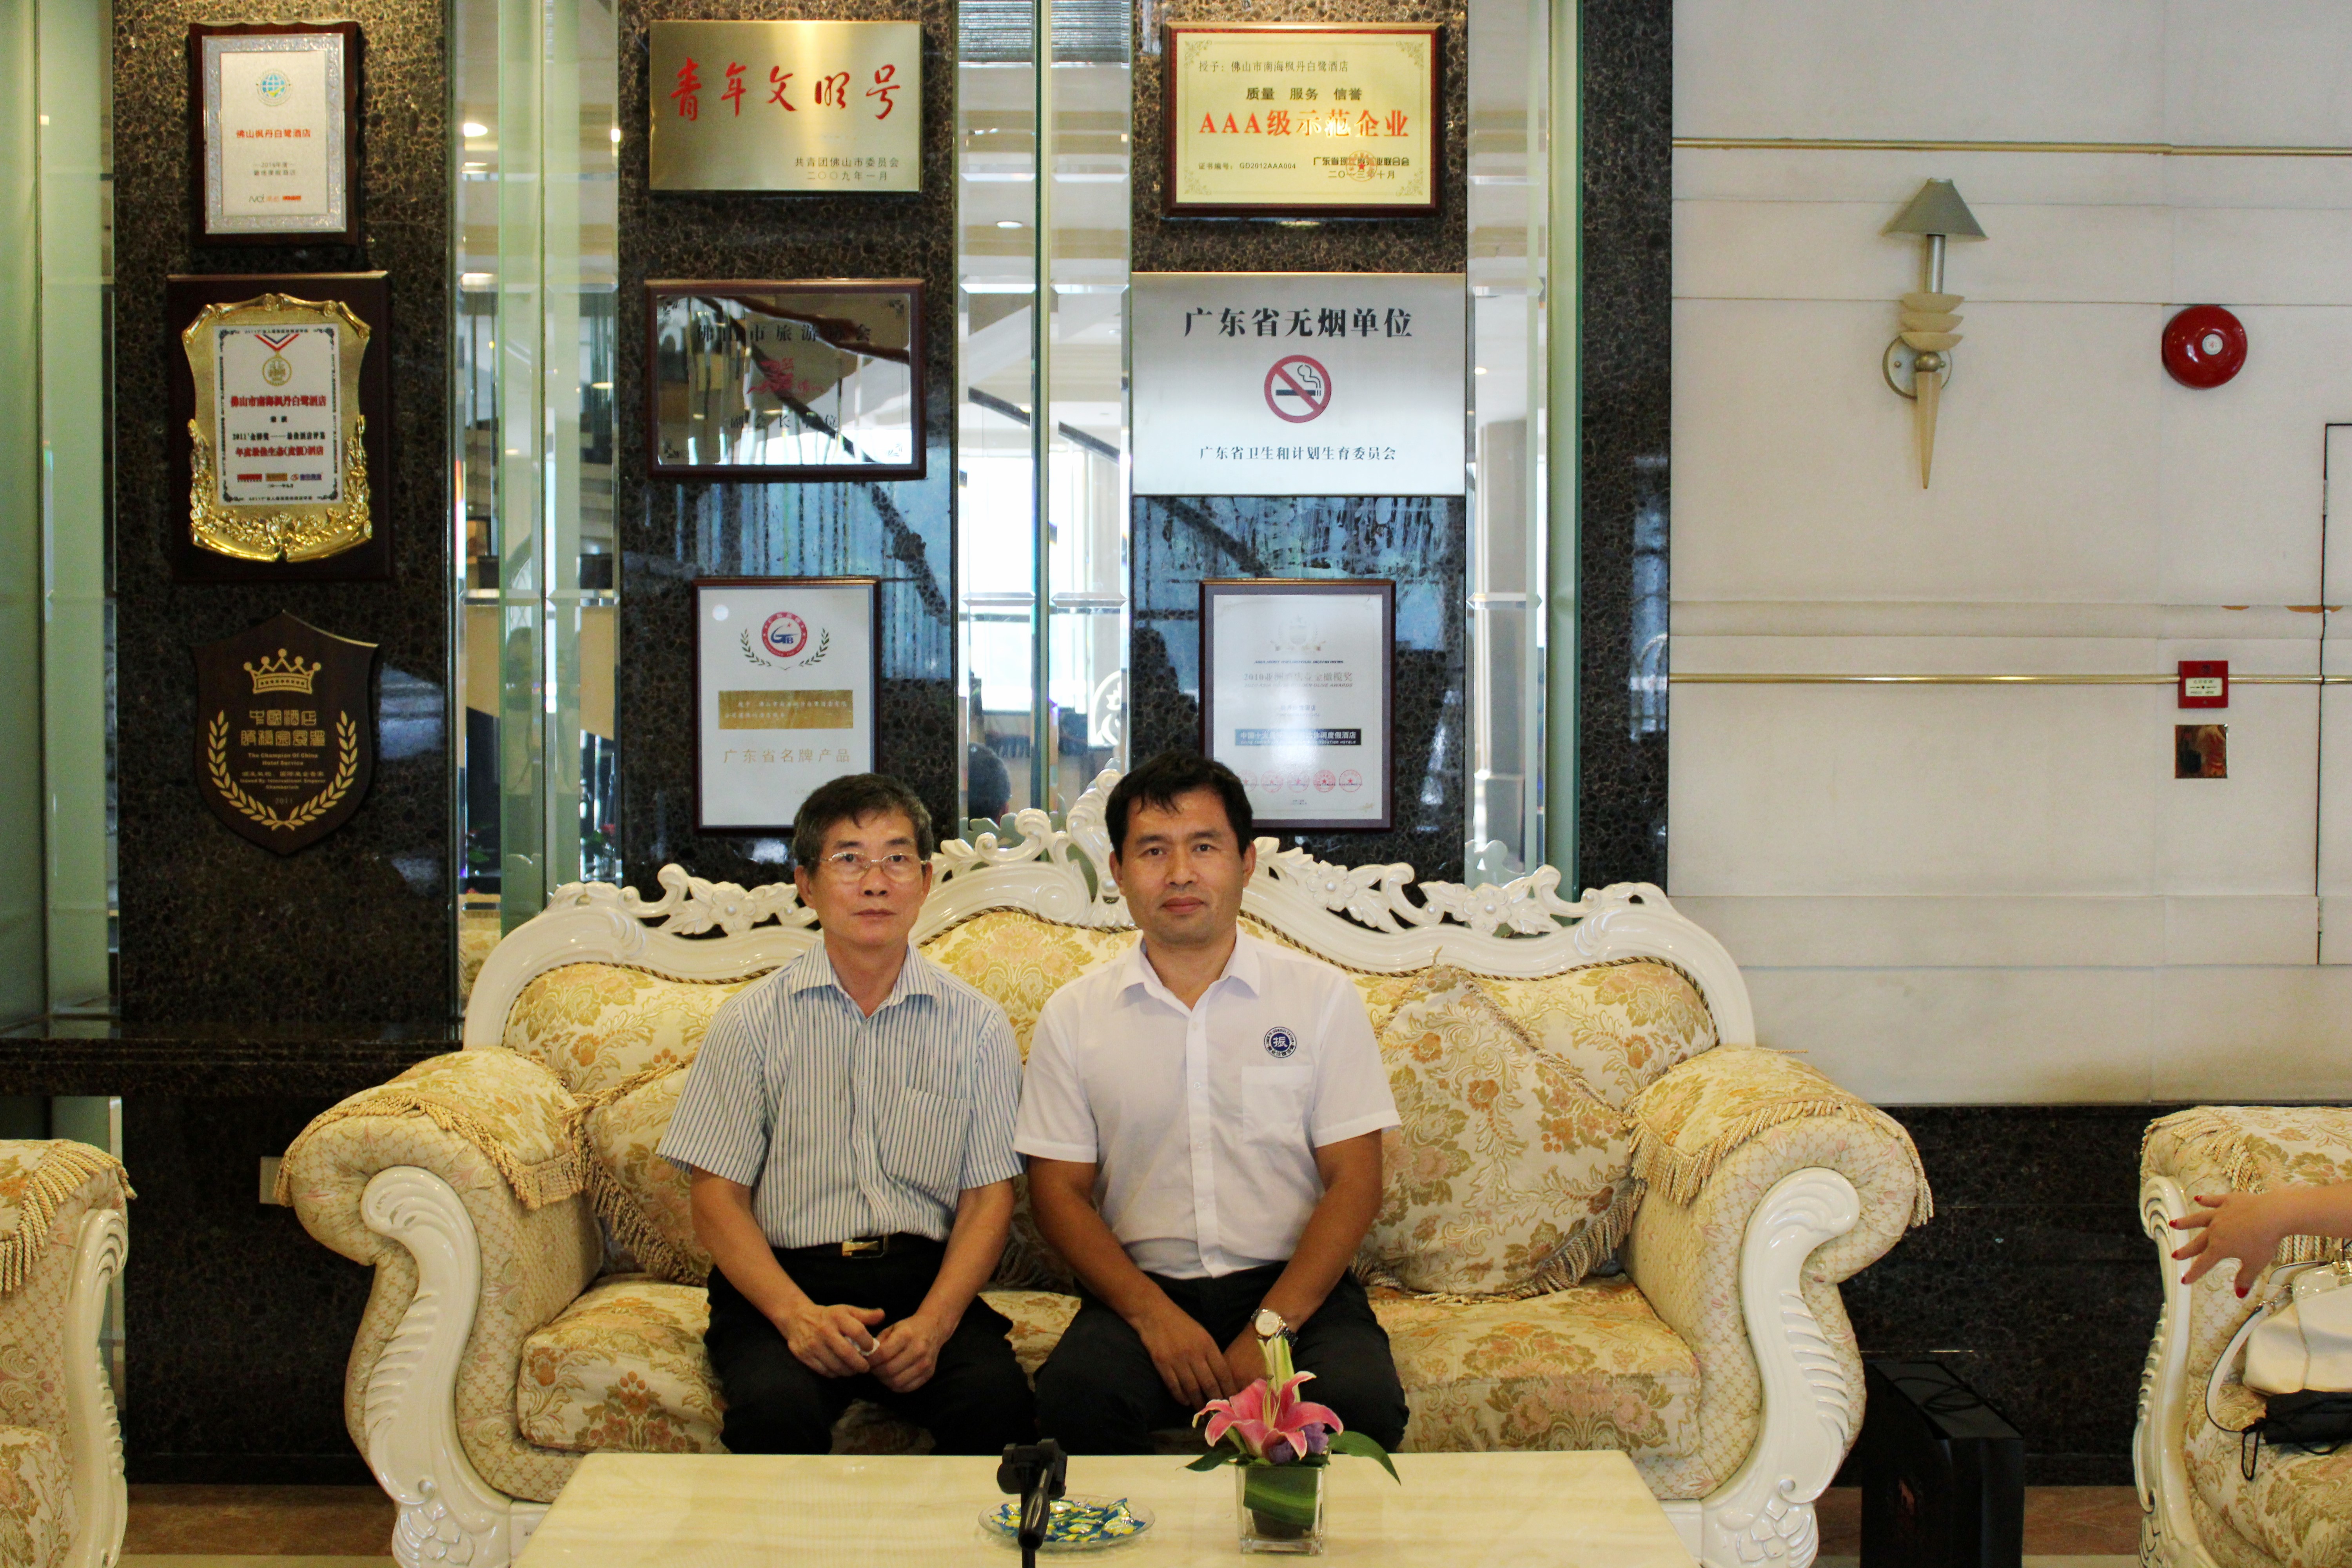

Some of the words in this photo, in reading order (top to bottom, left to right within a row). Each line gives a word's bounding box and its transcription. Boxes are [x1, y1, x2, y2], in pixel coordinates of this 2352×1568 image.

[671, 57, 900, 121] 青年文明号
[1247, 87, 1274, 100] 质量
[1290, 87, 1318, 100] 服务
[1334, 87, 1362, 100] 信誉
[795, 157, 898, 167] 共青团佛山市委员会
[1184, 307, 1412, 338] 广东省无烟单位
[1200, 446, 1396, 461] 广东省卫生和计划生育委员会
[723, 749, 850, 764] 广东省名牌产品
